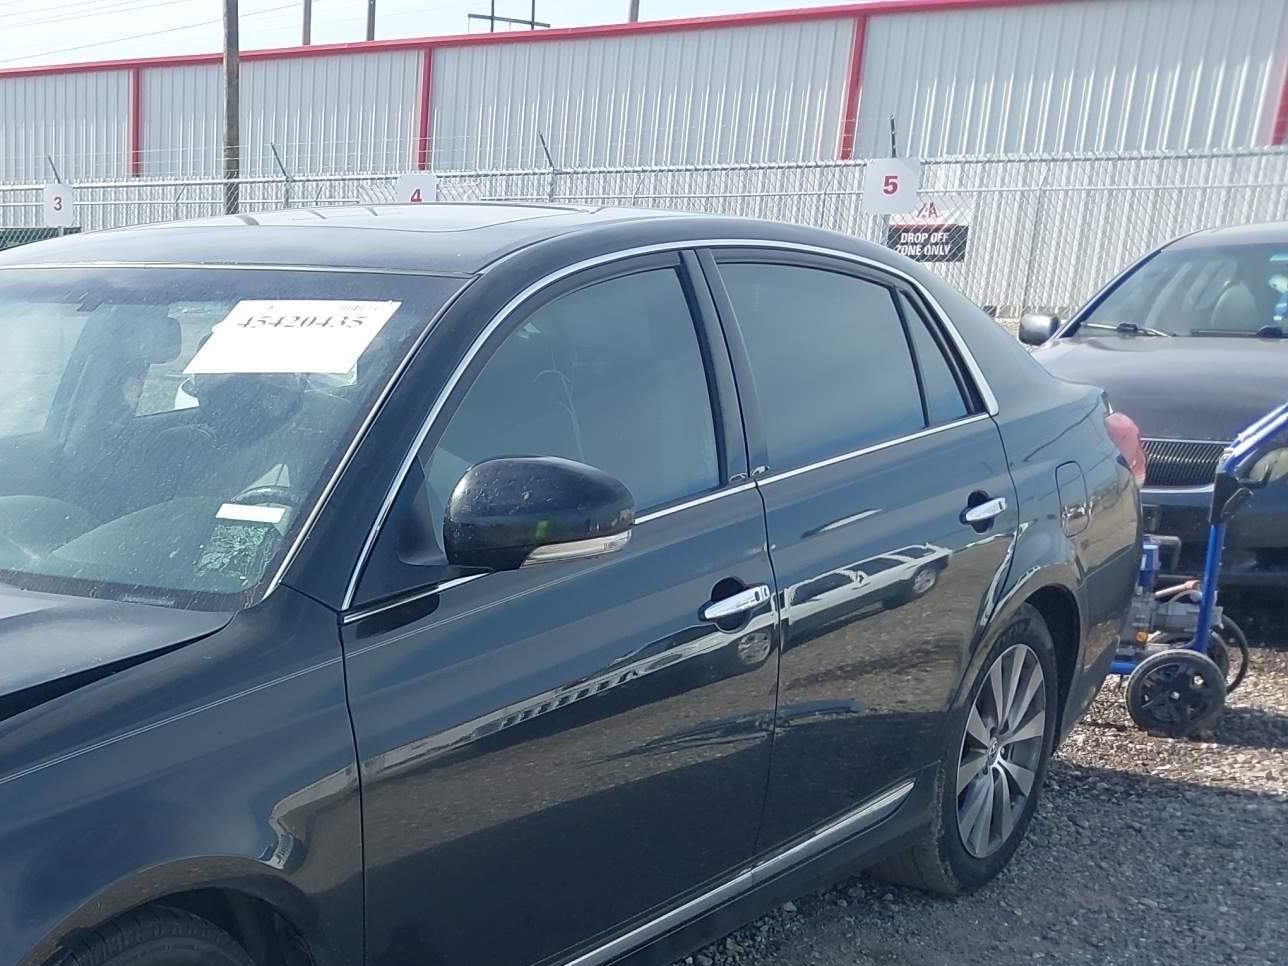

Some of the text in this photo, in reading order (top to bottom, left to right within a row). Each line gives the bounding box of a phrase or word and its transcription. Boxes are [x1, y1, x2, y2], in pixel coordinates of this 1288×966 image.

[883, 175, 898, 195] 5
[410, 188, 423, 203] 4
[53, 196, 63, 212] 3
[900, 232, 950, 243] DROP OFF
[895, 244, 951, 256] ZONE ONLY
[237, 315, 367, 329] 45420435
